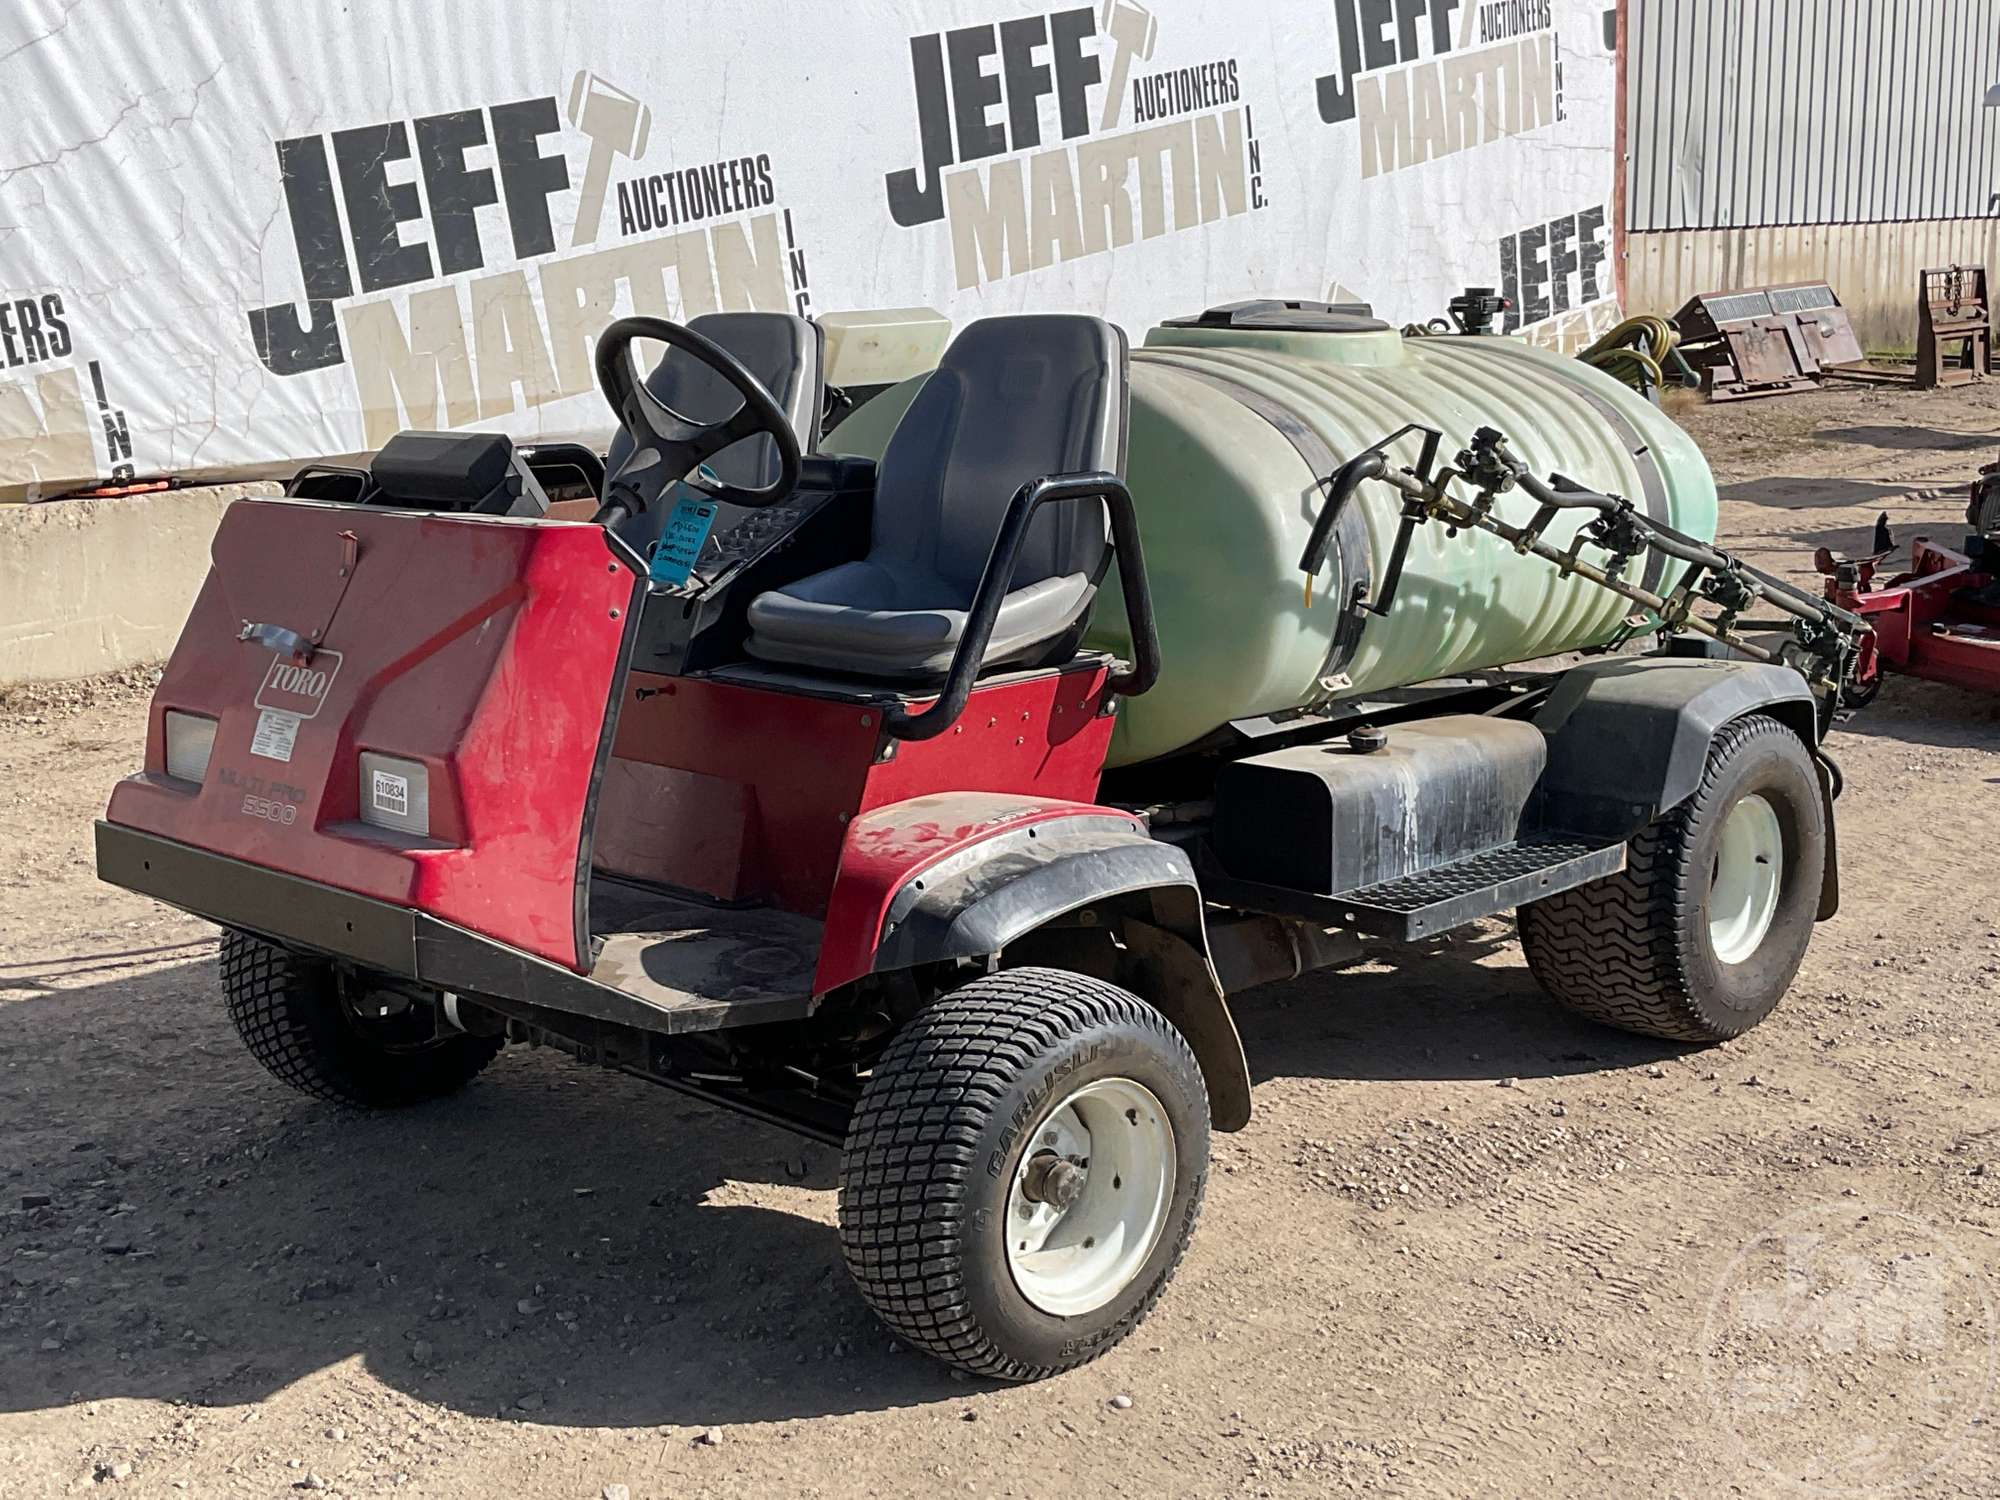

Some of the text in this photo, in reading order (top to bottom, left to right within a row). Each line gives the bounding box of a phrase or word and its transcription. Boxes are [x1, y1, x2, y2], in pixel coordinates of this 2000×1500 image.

[1480, 0, 1551, 43] AUCTIONEERS
[886, 7, 1101, 228] JEFF
[1133, 58, 1240, 125] AUCTIONEERS
[1356, 33, 1553, 179] MARTIN
[616, 153, 775, 236] AUCTIONEERS
[945, 105, 1248, 290] MARTIN
[1246, 105, 1268, 210] INC.
[248, 96, 570, 376] JEFF
[341, 213, 787, 451] MARTIN
[269, 663, 326, 697] TORO
[241, 794, 297, 825] 5500
[375, 780, 405, 799] 610834
